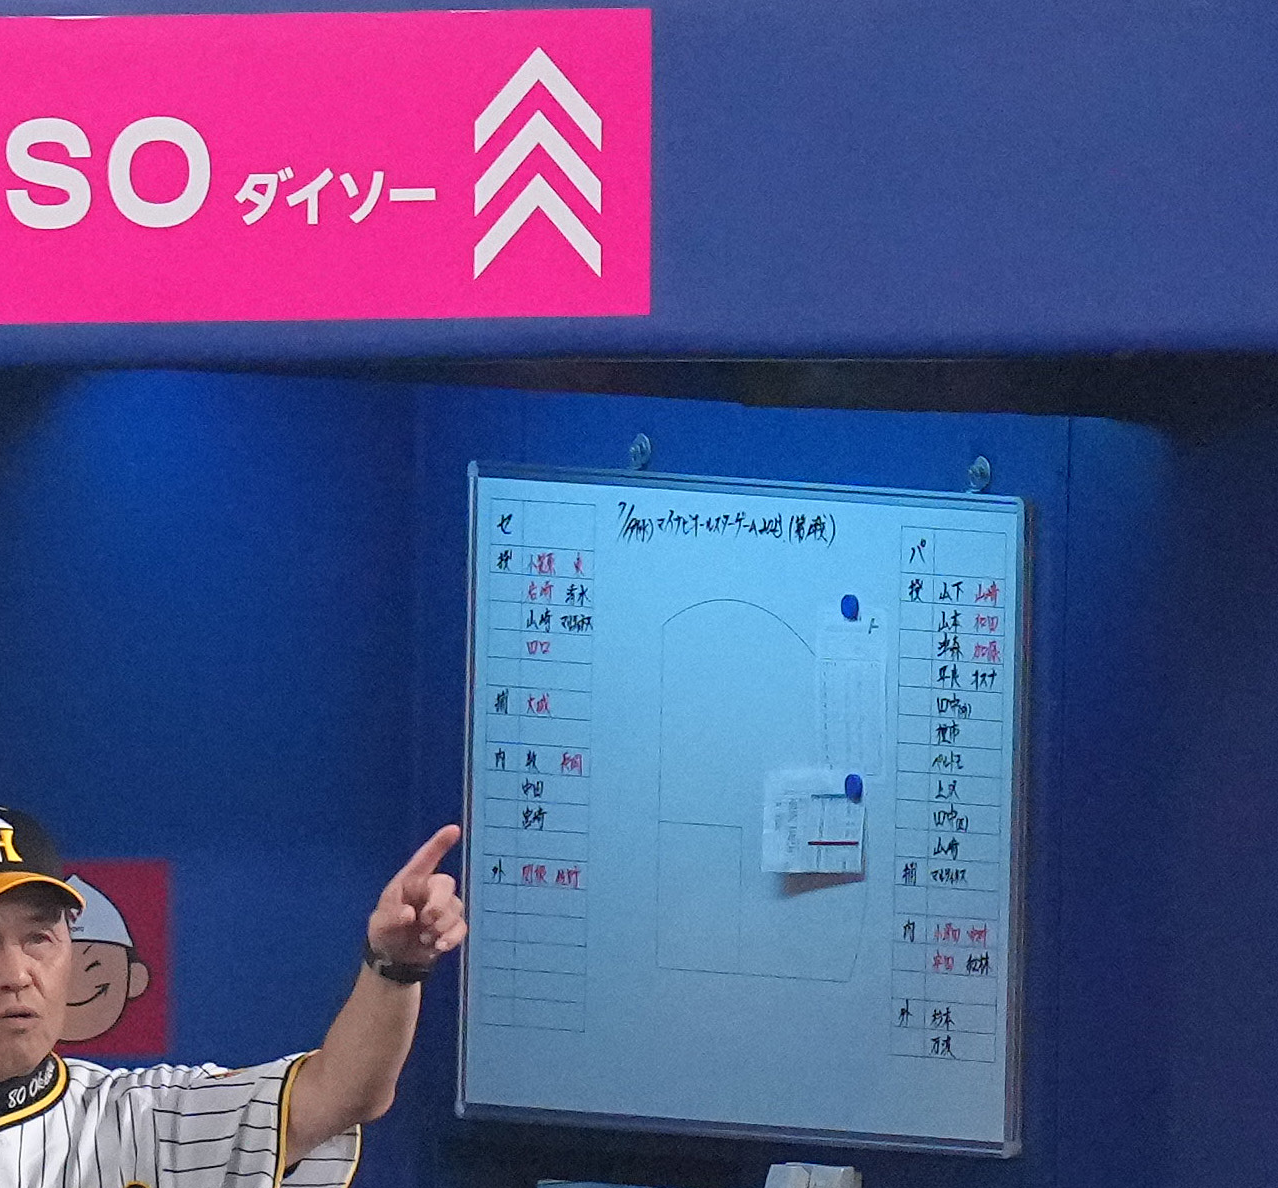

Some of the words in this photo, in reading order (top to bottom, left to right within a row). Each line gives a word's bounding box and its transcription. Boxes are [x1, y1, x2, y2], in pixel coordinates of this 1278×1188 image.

[234, 167, 437, 227] ダイソー
[909, 538, 927, 563] パ
[939, 581, 964, 602] 山下
[939, 609, 963, 633] 山本
[971, 668, 998, 691] オスナ
[8, 1085, 26, 1109] 80
